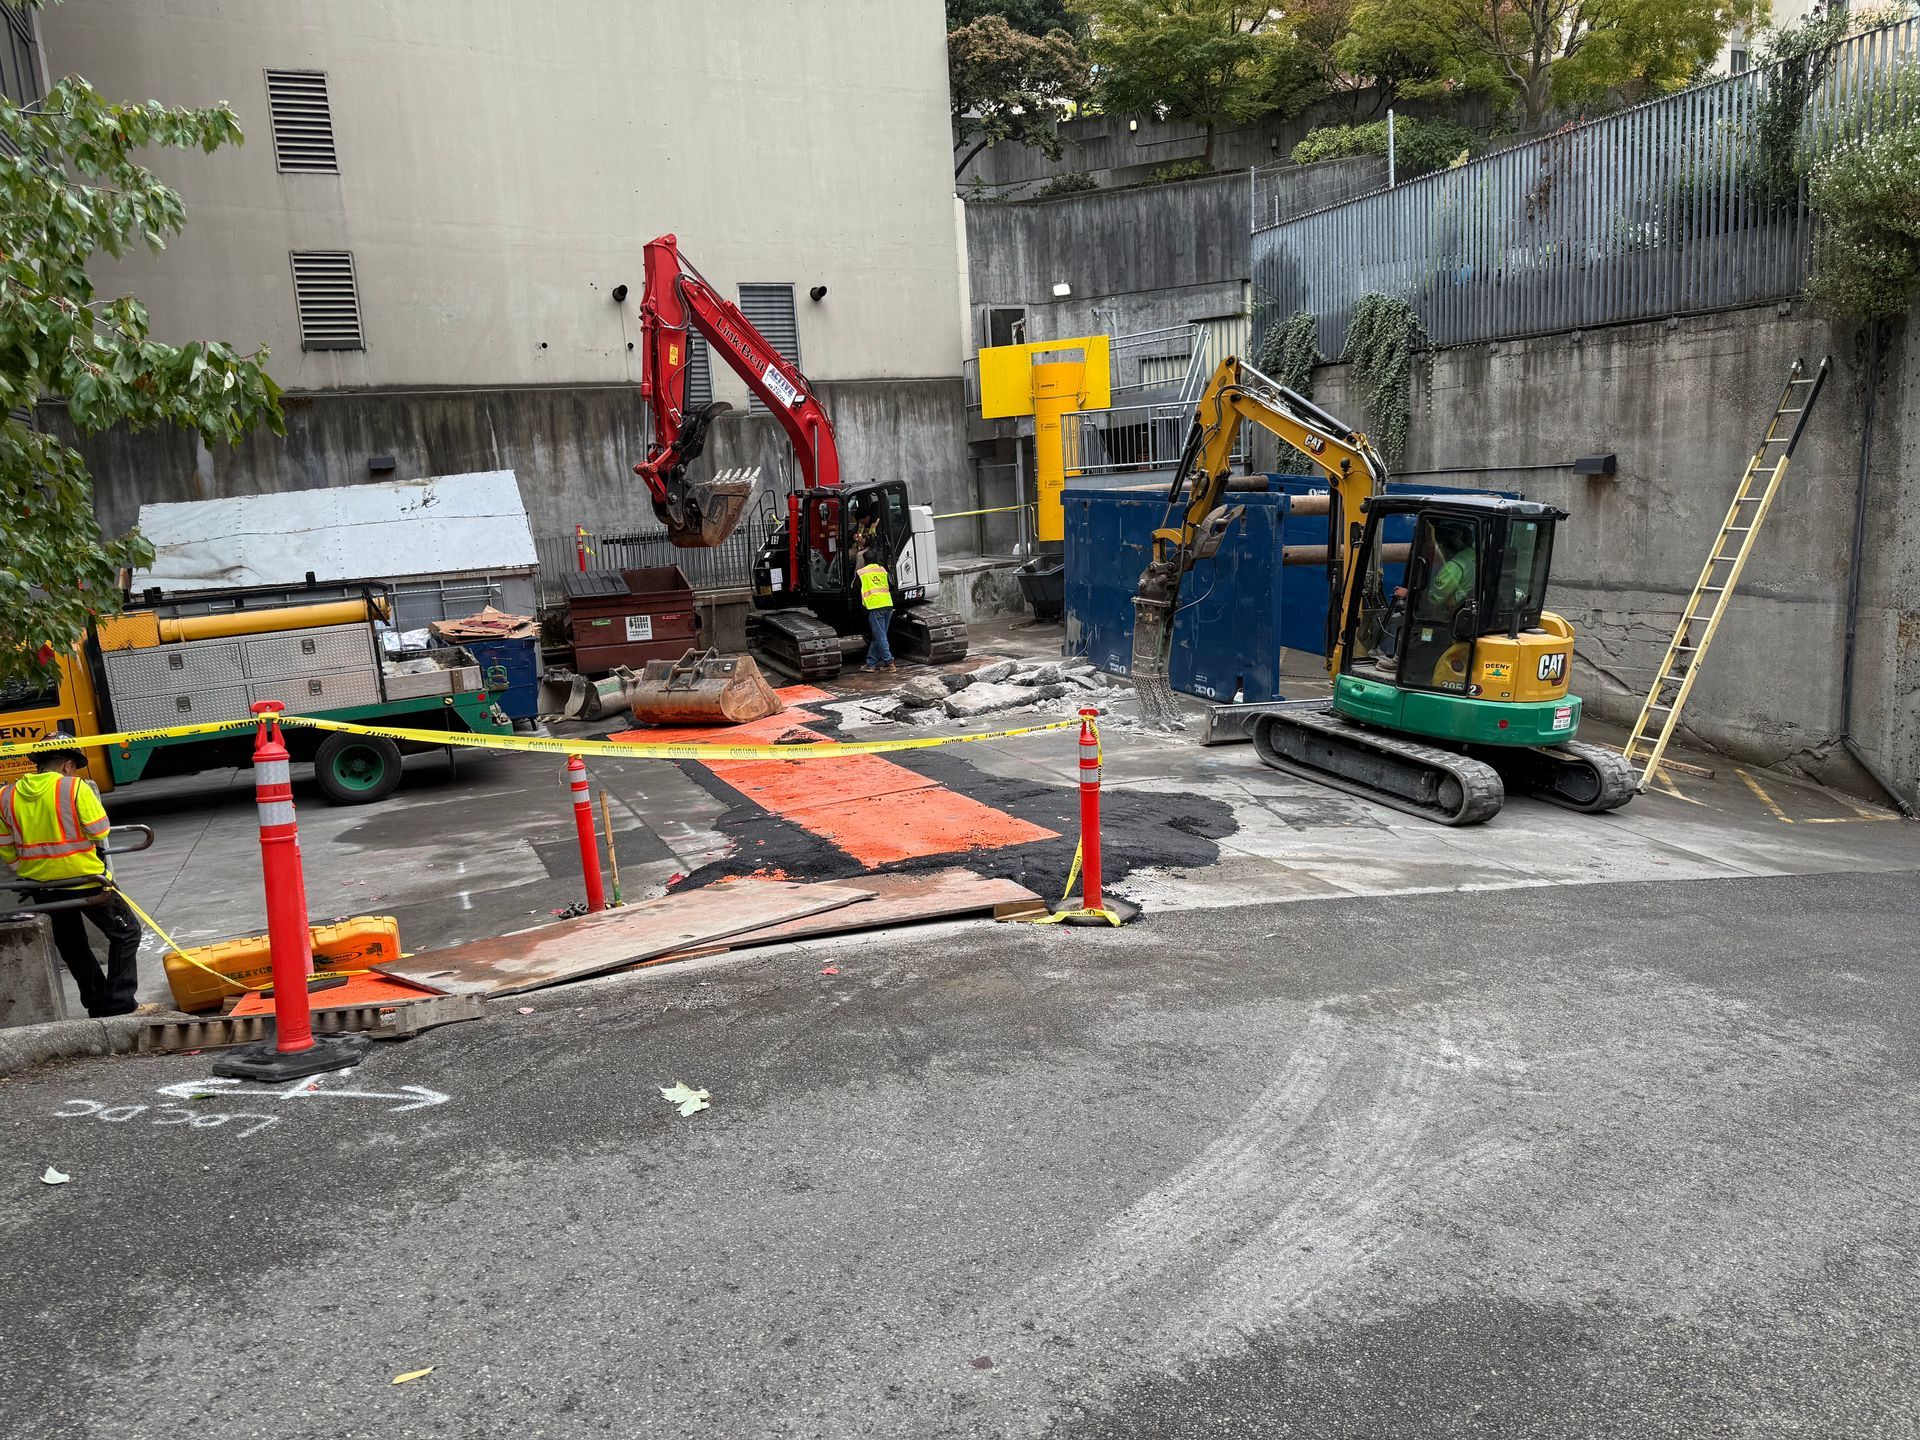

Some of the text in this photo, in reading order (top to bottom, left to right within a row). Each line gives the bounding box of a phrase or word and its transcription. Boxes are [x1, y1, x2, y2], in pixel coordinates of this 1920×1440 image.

[716, 316, 766, 374] Link-Belt
[768, 367, 796, 396] ACTIVE
[1304, 433, 1324, 452] CAT
[1538, 654, 1565, 680] CAT
